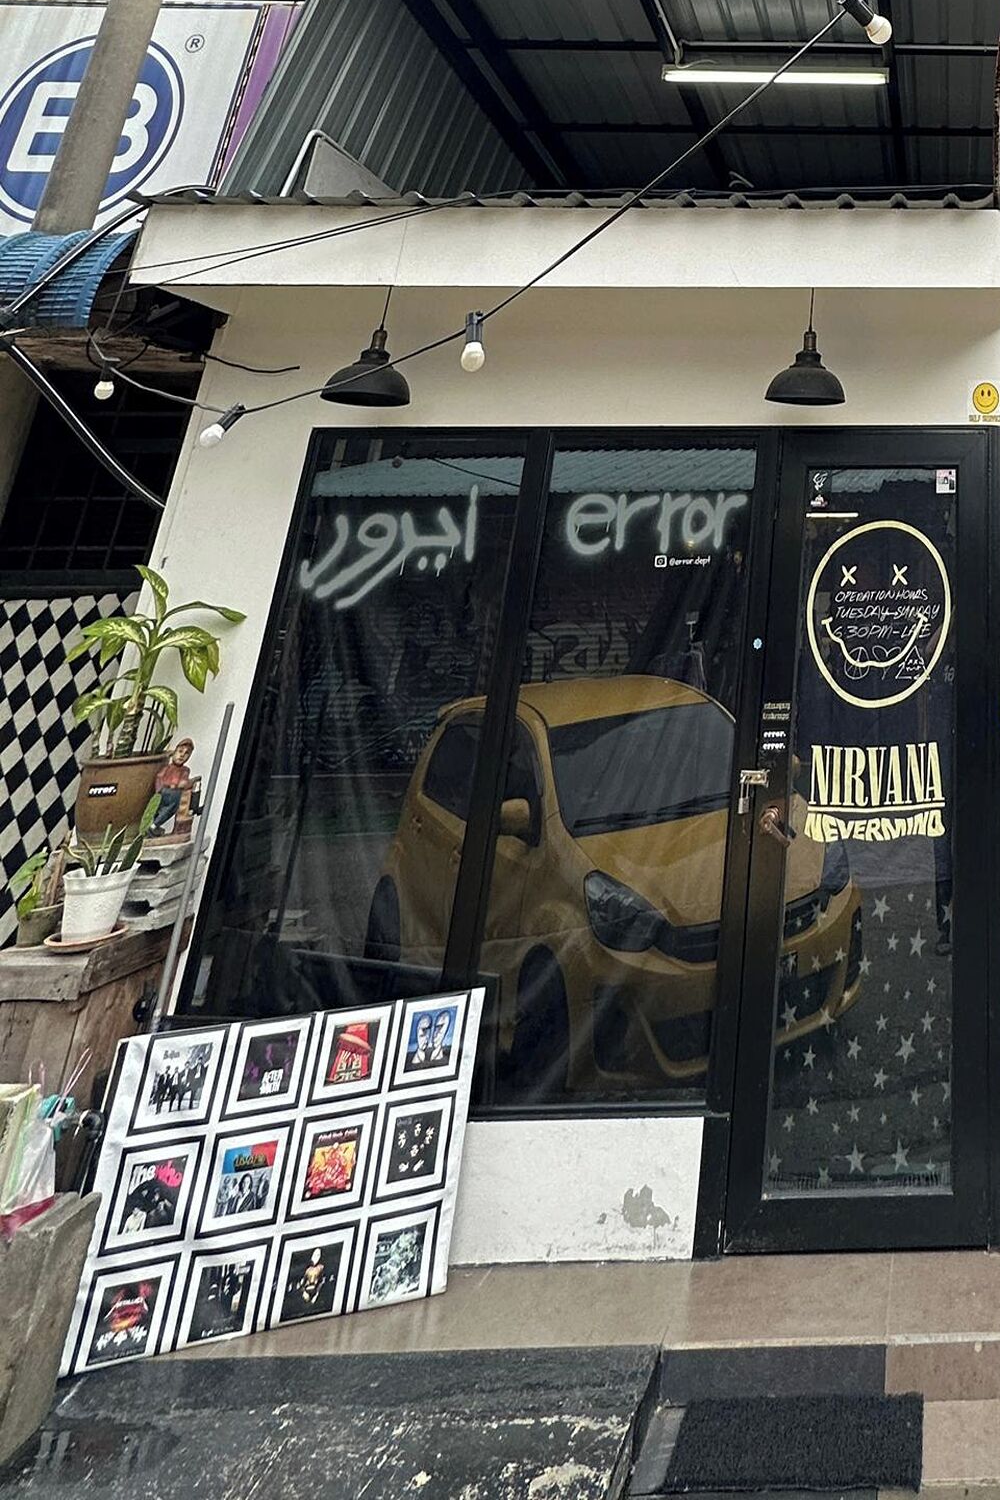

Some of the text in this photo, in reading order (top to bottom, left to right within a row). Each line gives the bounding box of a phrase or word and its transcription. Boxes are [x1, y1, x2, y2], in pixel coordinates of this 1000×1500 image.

[565, 491, 748, 556] error
[834, 590, 895, 603] OPERATION
[808, 741, 946, 807] NIRVANA
[803, 808, 946, 843] NEVERMIND
